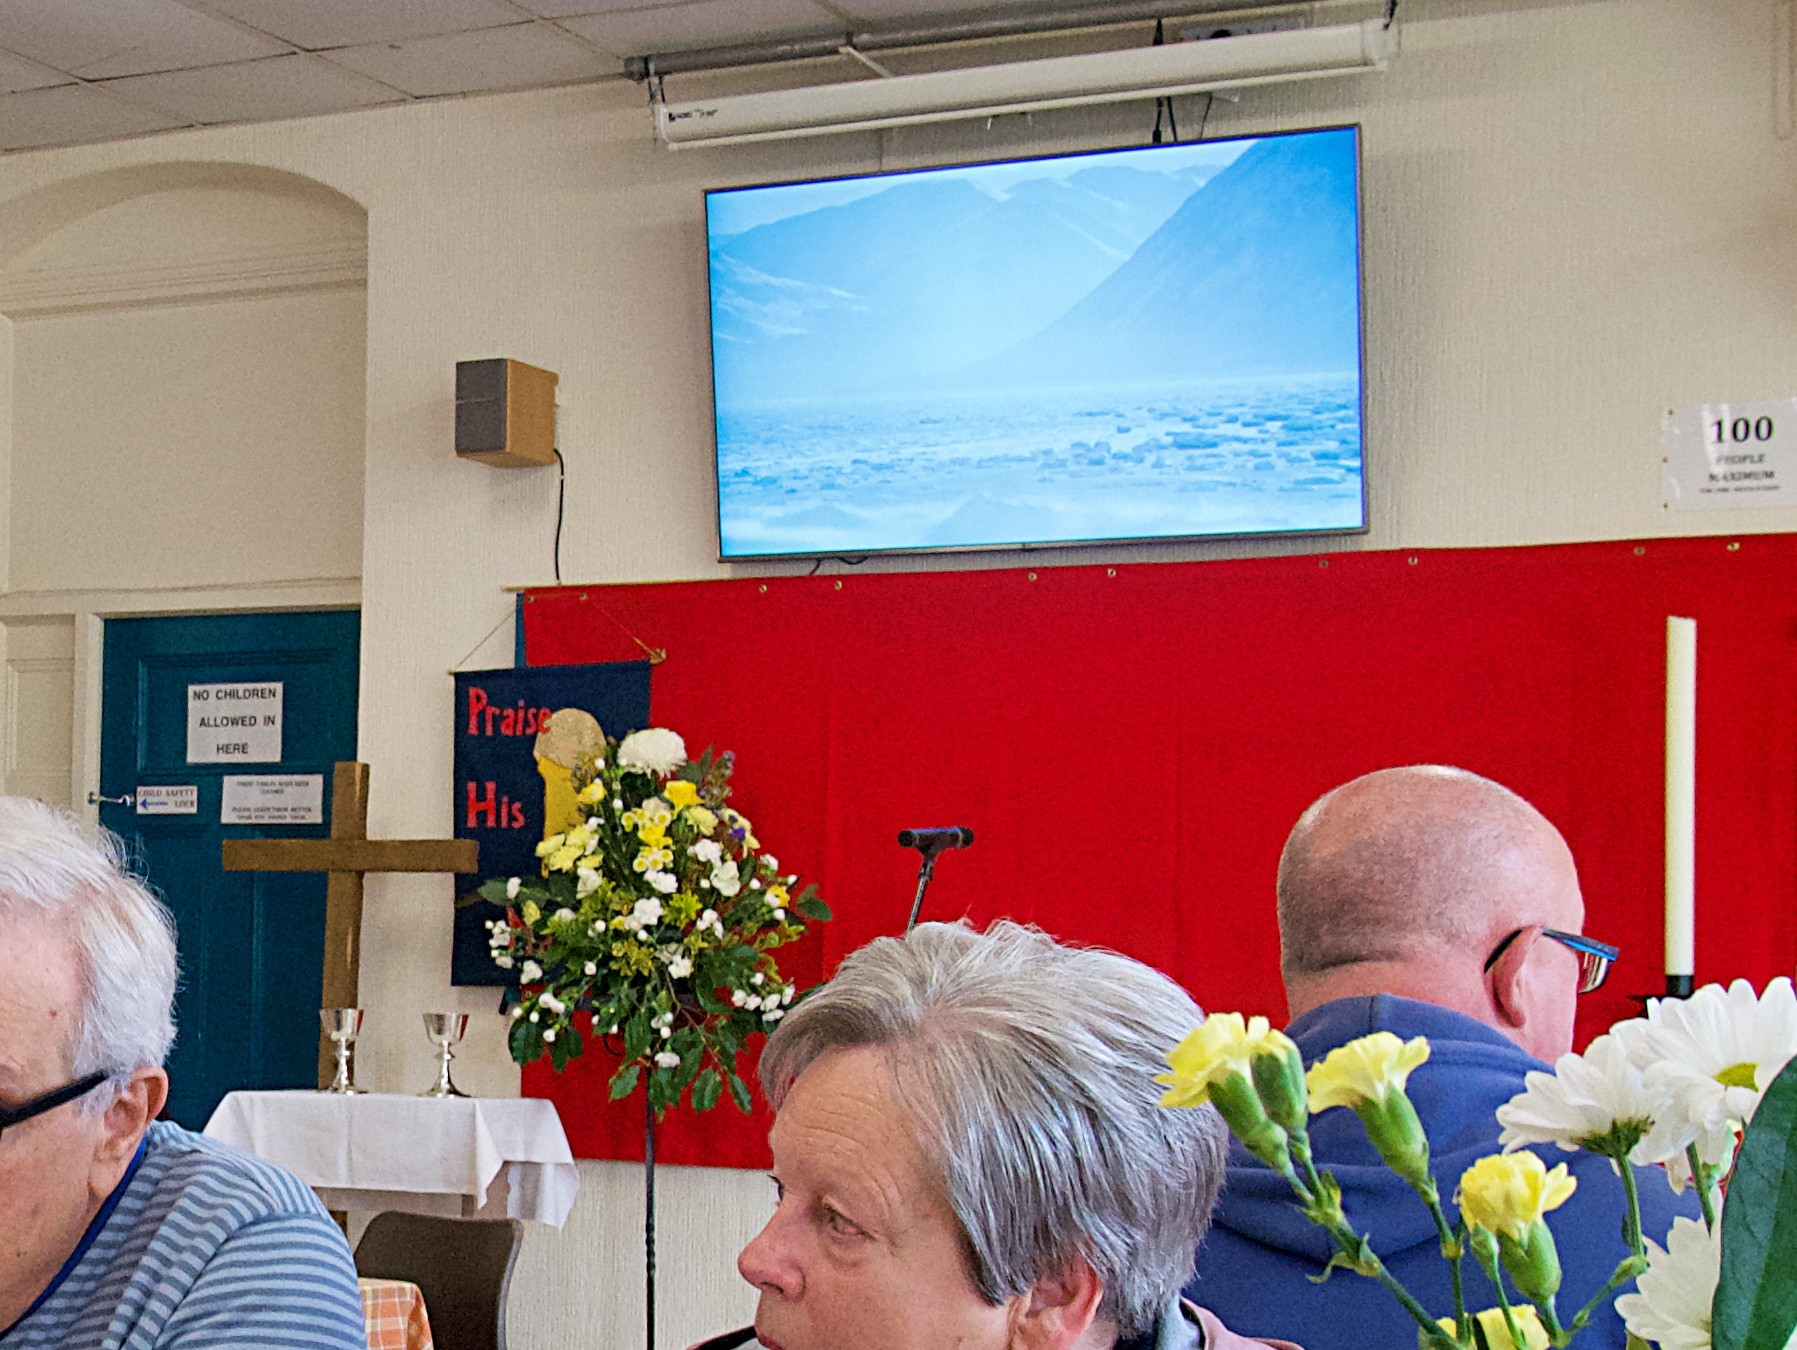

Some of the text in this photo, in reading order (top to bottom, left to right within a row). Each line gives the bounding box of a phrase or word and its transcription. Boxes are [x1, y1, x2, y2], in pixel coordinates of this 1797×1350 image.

[1710, 416, 1774, 443] 100
[193, 687, 277, 701] NO CHILDREN
[199, 714, 276, 728] ALLOWED IN
[467, 686, 552, 737] Praise
[216, 742, 249, 755] HERE
[466, 780, 526, 829] His
